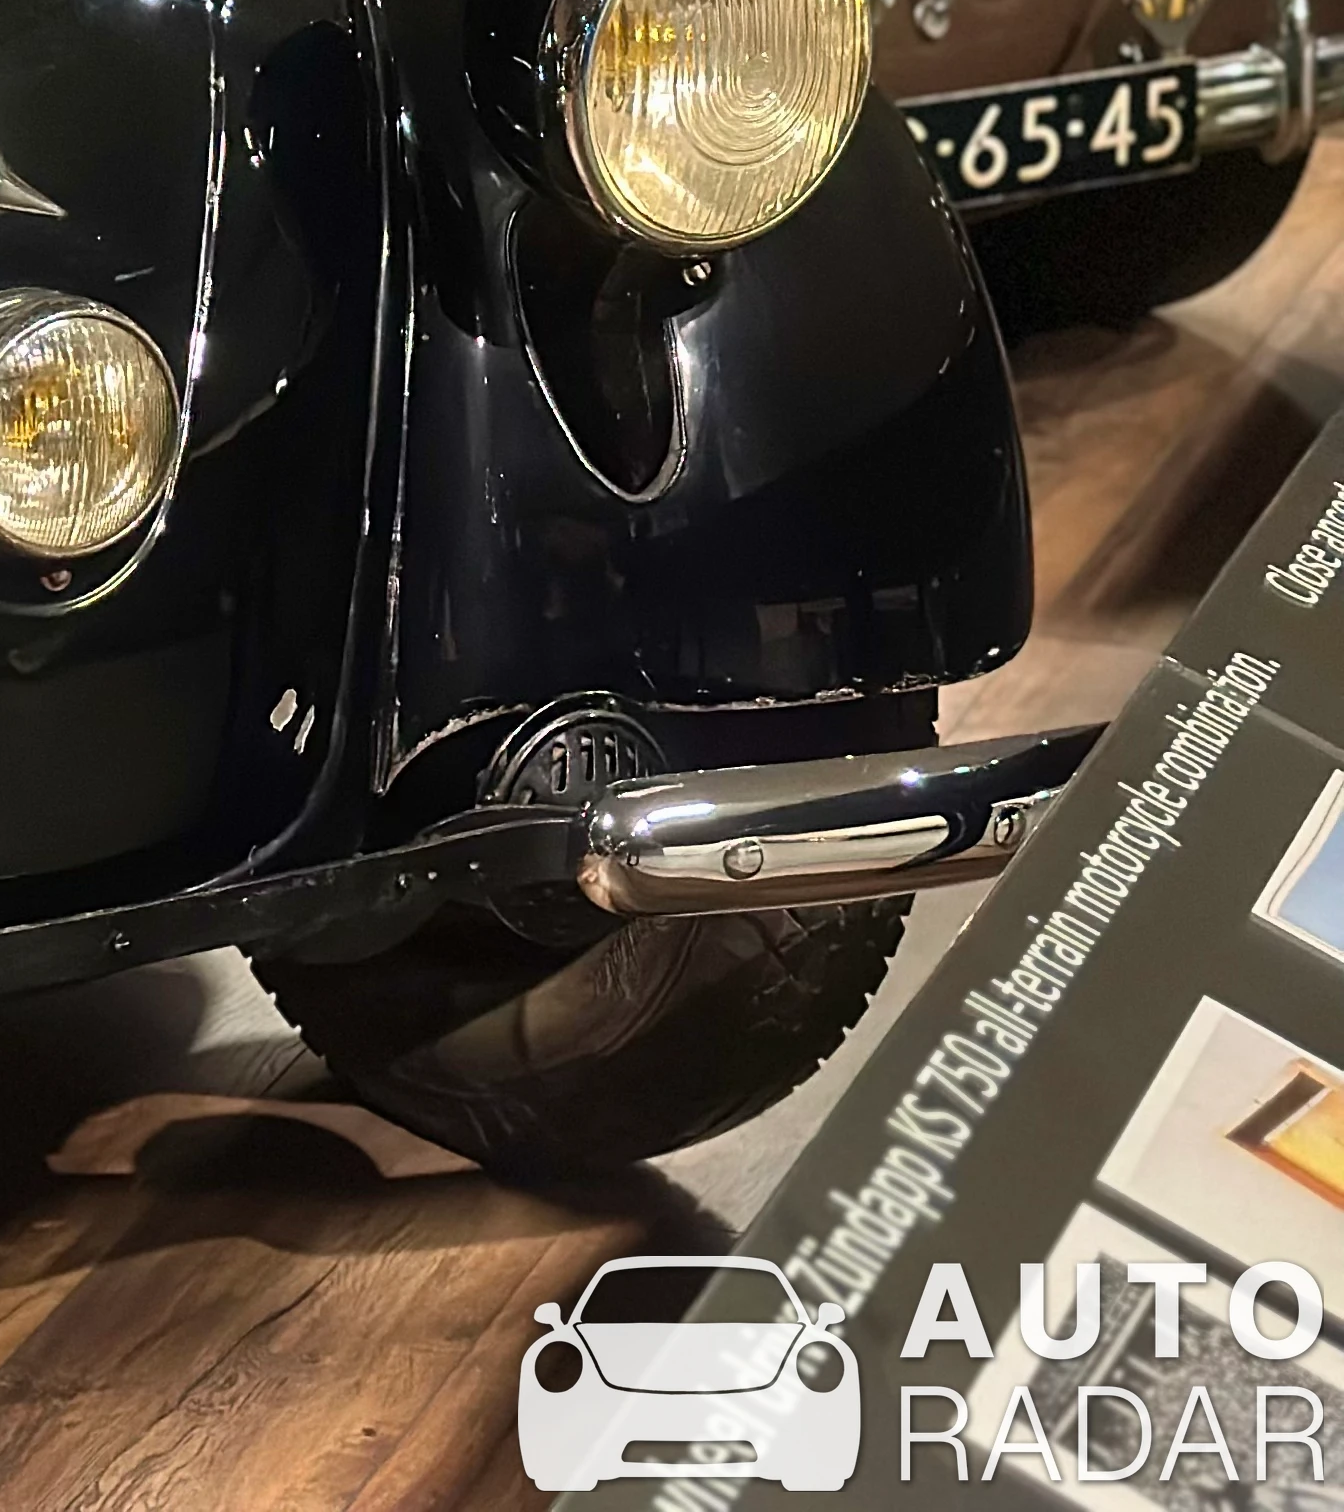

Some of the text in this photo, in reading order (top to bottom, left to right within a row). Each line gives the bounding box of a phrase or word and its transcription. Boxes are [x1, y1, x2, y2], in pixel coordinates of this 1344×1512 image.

[1266, 544, 1341, 604] Close
[1064, 780, 1188, 922] motorcycle
[965, 911, 1101, 1056] all-terrain
[887, 1094, 971, 1160] KS
[916, 1034, 1011, 1114] 750
[785, 1146, 956, 1317] Zündapp
